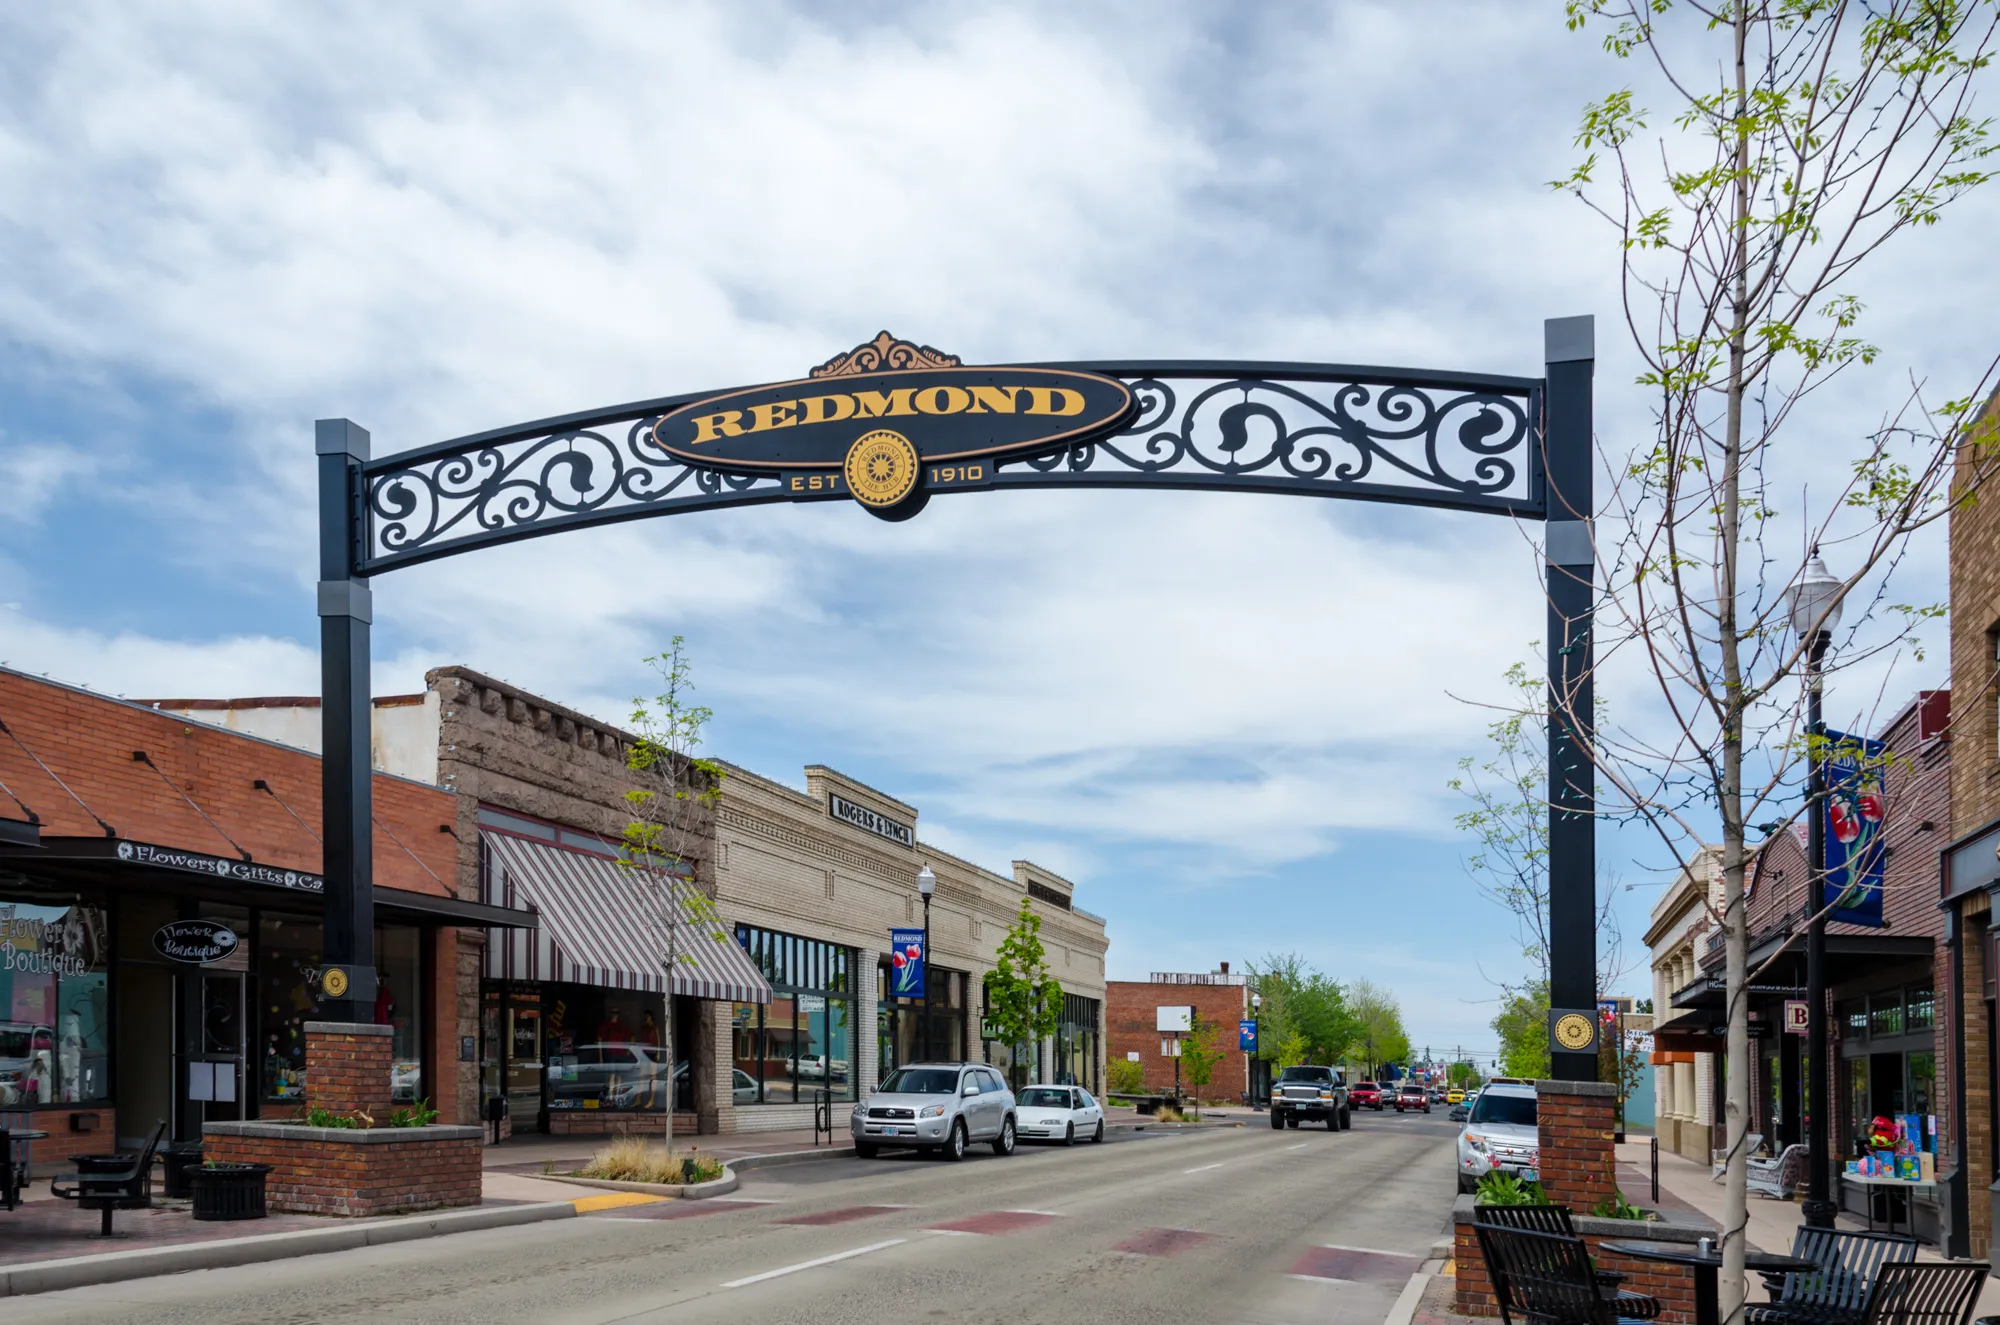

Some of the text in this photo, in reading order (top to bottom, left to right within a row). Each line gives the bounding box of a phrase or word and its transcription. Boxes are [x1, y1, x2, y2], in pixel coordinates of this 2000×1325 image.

[691, 386, 1086, 445] REDMOND
[863, 444, 900, 462] REDMOND
[791, 466, 983, 490] EST 1910
[837, 800, 909, 844] ROGERS & LYNCH
[136, 845, 216, 871] Flowers
[232, 863, 284, 884] Gifts
[0, 904, 63, 944] Flower
[1, 939, 86, 982] Boutique
[163, 939, 221, 961] Boutique
